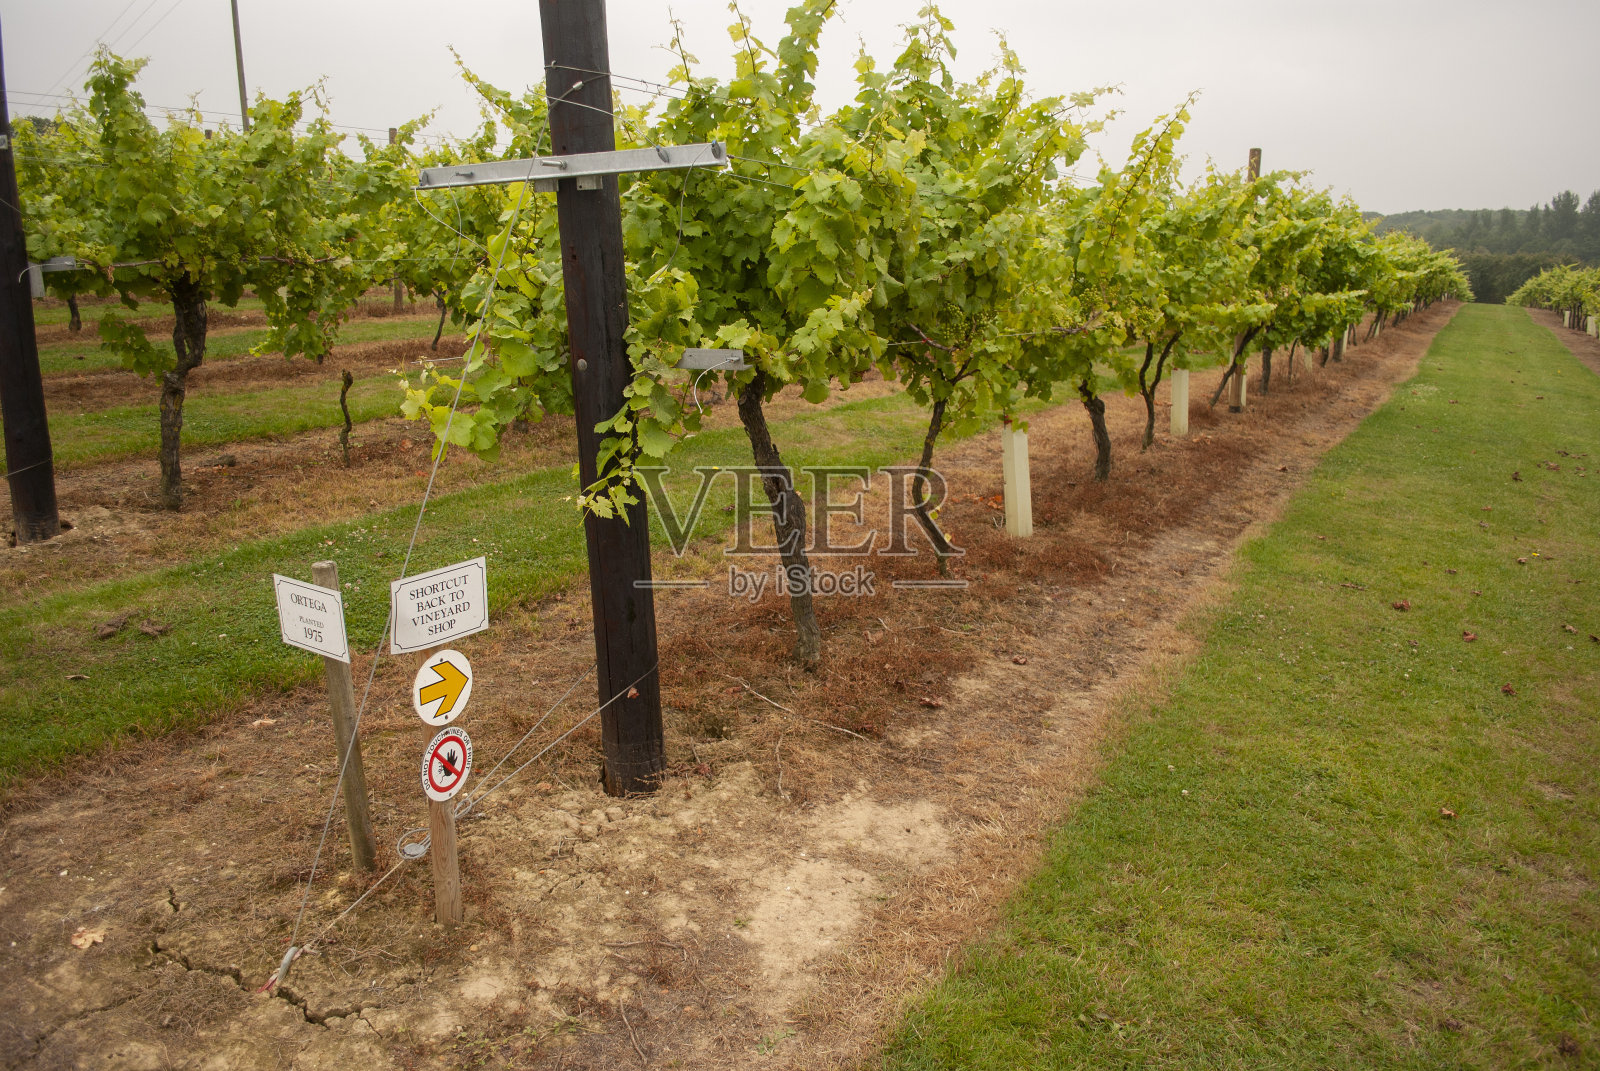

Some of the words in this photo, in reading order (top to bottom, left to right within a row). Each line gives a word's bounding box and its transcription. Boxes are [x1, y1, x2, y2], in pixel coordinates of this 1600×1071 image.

[409, 574, 469, 601] SHORTCUT
[290, 592, 327, 613] ORTEGA
[416, 594, 446, 612] BACK
[449, 589, 465, 603] TO
[299, 615, 325, 629] PLANTED
[412, 601, 470, 627] VINEYARD
[303, 626, 323, 643] 1975
[428, 618, 456, 636] SHOP
[423, 778, 431, 791] DO
[427, 732, 447, 755] TOUCH
[463, 735, 470, 747] OR
